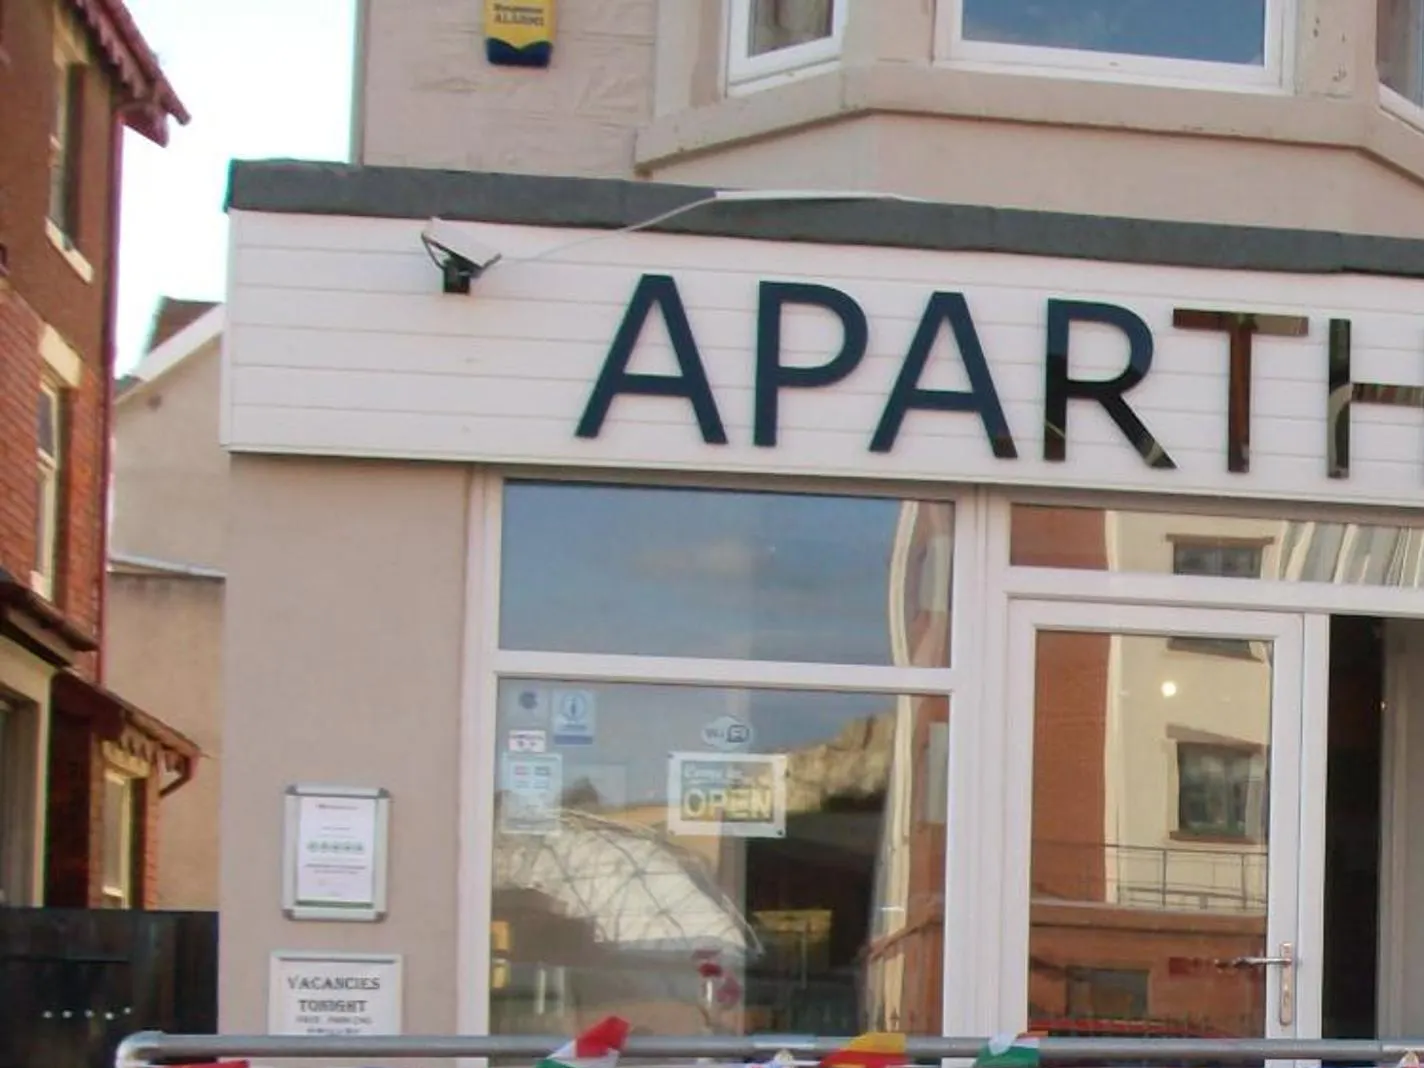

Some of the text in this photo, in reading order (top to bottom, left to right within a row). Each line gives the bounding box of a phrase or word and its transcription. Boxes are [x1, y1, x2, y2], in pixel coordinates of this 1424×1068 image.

[683, 788, 772, 820] OPEN
[287, 975, 380, 990] VACANCIES
[298, 999, 368, 1013] TONIGHT
